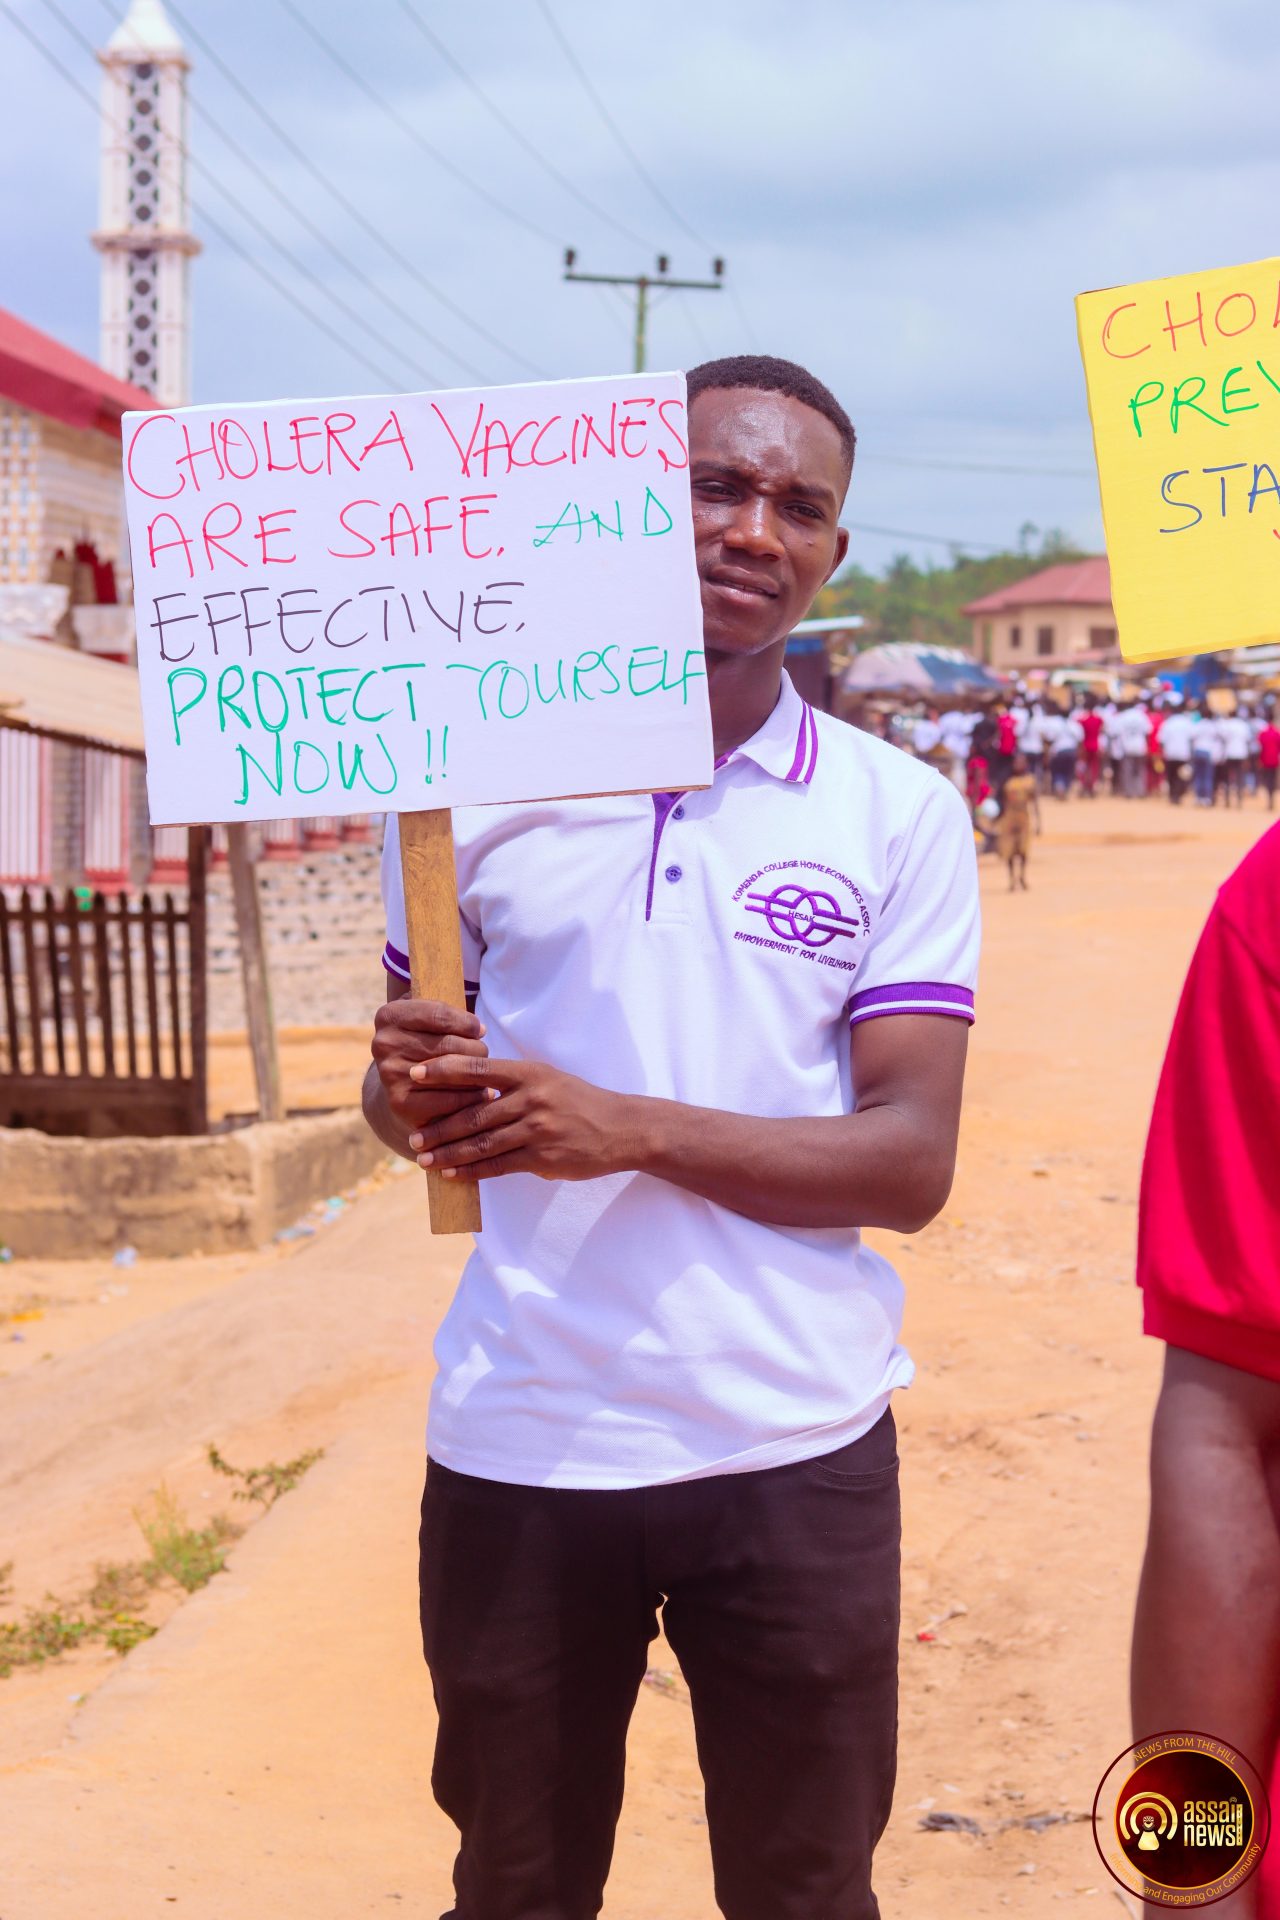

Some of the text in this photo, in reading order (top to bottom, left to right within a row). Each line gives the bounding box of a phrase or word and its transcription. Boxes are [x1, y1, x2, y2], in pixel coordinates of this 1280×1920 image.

[128, 398, 688, 499] CHOLERA VACCINES
[147, 503, 297, 578] ARE
[532, 487, 673, 548] AND
[167, 645, 706, 746] PROTECT YOURSELF
[234, 732, 398, 806] NOW
[732, 870, 764, 902] KOMENDA
[763, 860, 799, 873] COLLEGE
[799, 860, 825, 873] HOME
[824, 867, 864, 904] ECONOMICS
[733, 931, 857, 972] EMPOWERMENT FOR LIVELIHOOD
